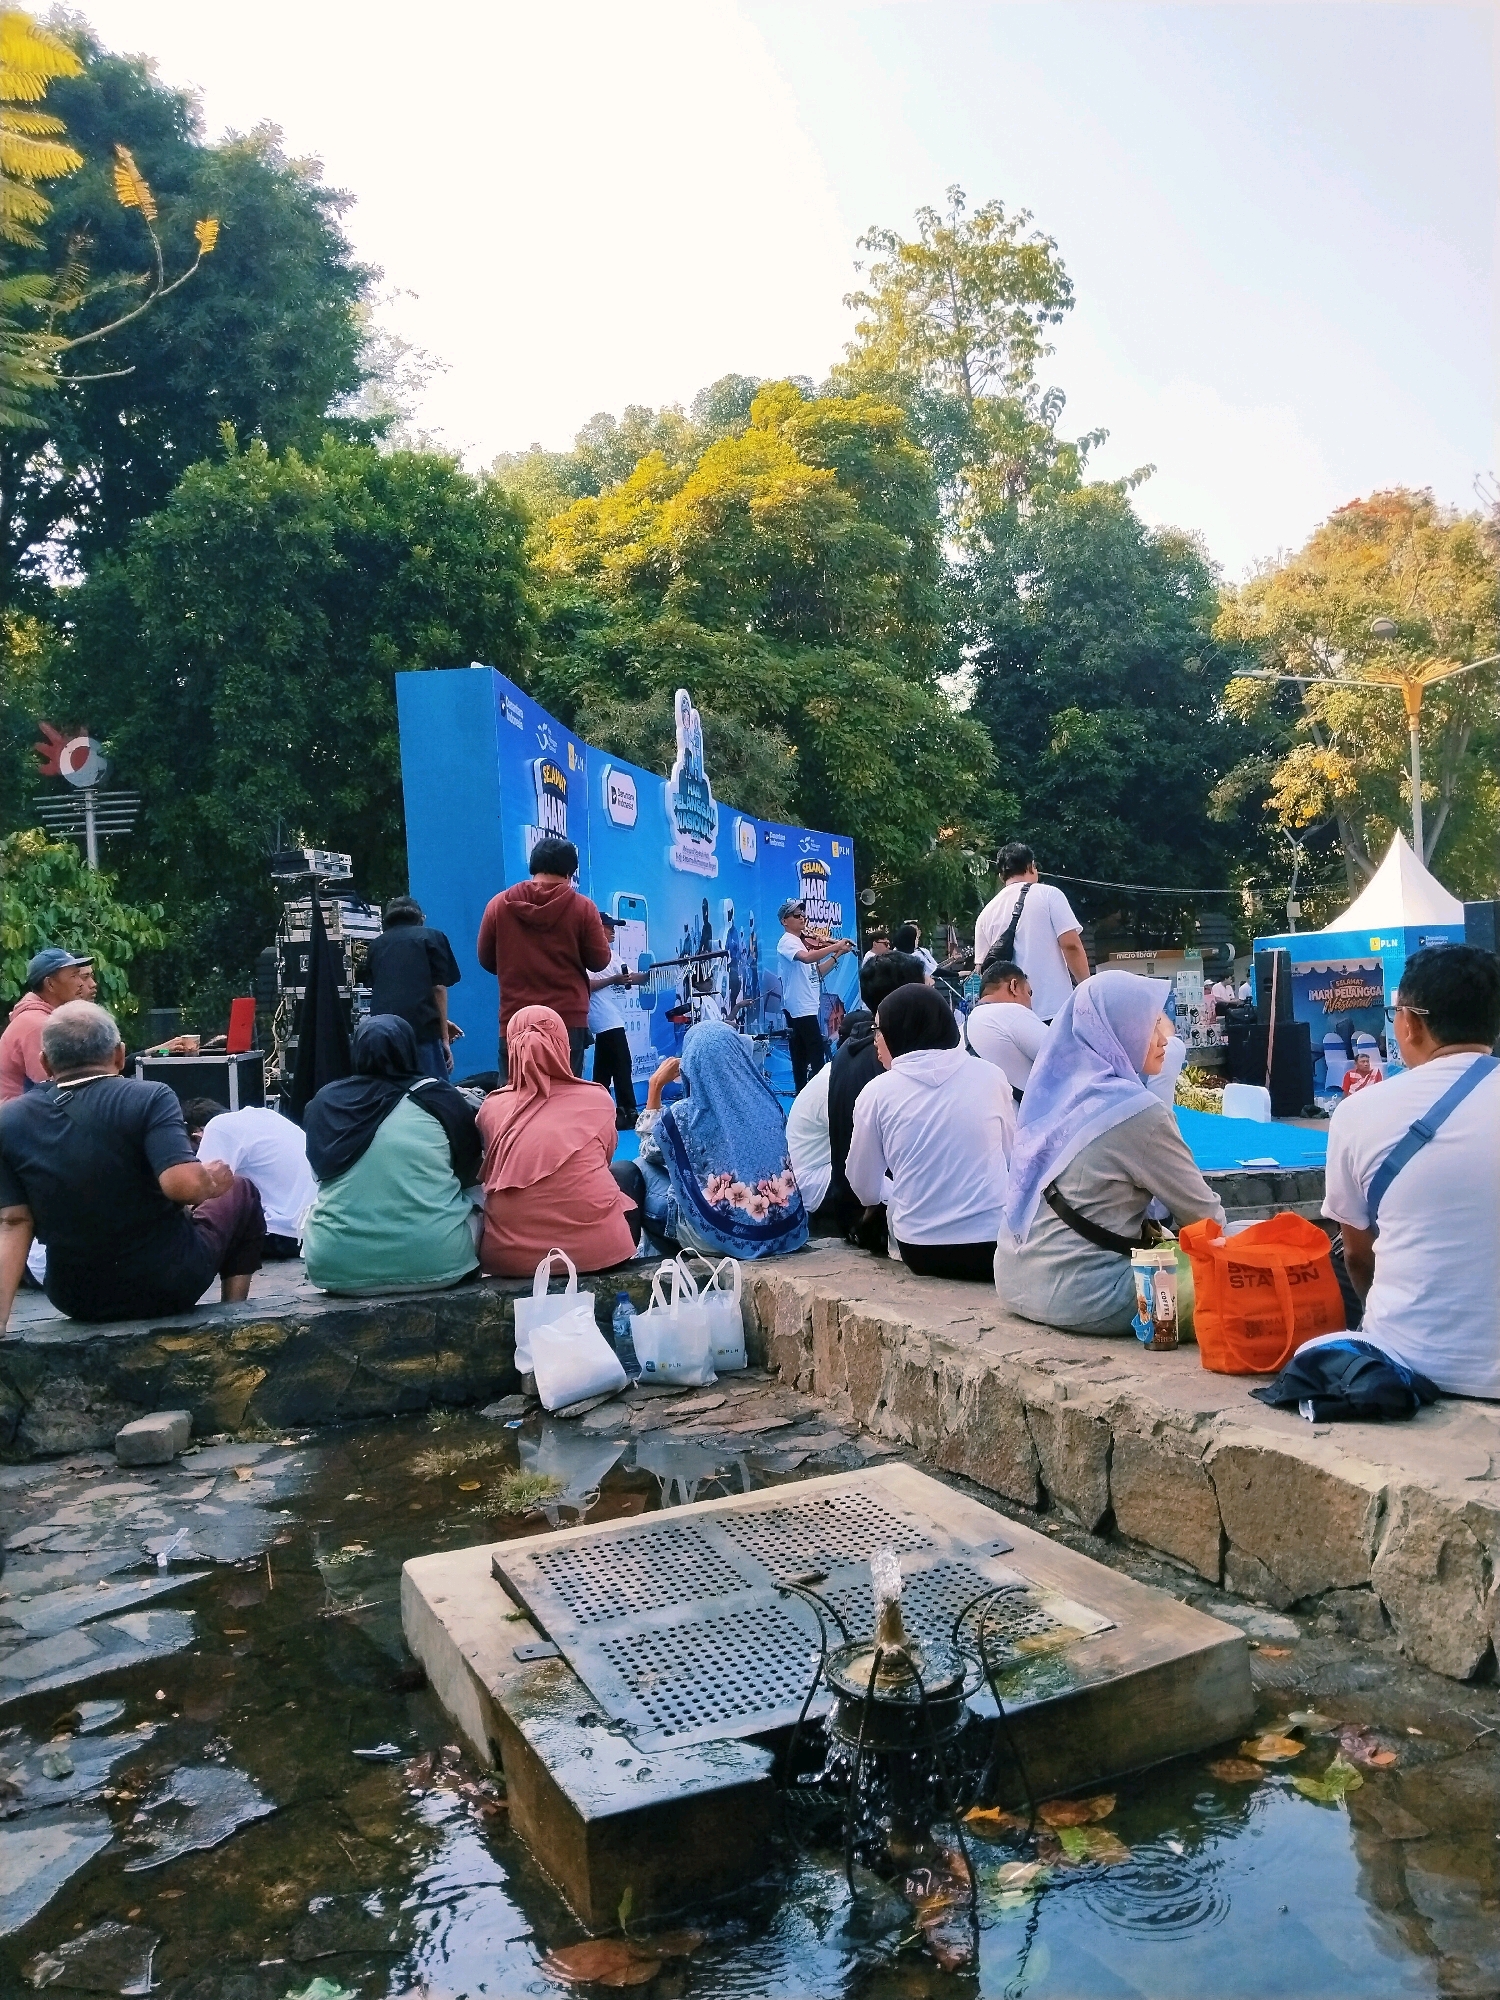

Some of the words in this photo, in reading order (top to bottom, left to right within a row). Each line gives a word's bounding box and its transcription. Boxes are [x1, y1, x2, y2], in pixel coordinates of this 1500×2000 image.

[543, 765, 567, 796] SELAMAT
[544, 793, 567, 839] HARI
[677, 811, 713, 838] NASIONAL
[802, 862, 827, 877] SELAMA
[802, 878, 827, 900] HARI
[787, 898, 842, 923] ANGGAN
[1380, 938, 1399, 948] PLN
[1136, 951, 1158, 960] library
[1335, 979, 1364, 987] SELAMAT
[1310, 988, 1333, 1001] HARI
[1323, 997, 1371, 1014] Nasional
[1229, 1267, 1320, 1289] STAON
[1160, 1290, 1170, 1317] COFFEE
